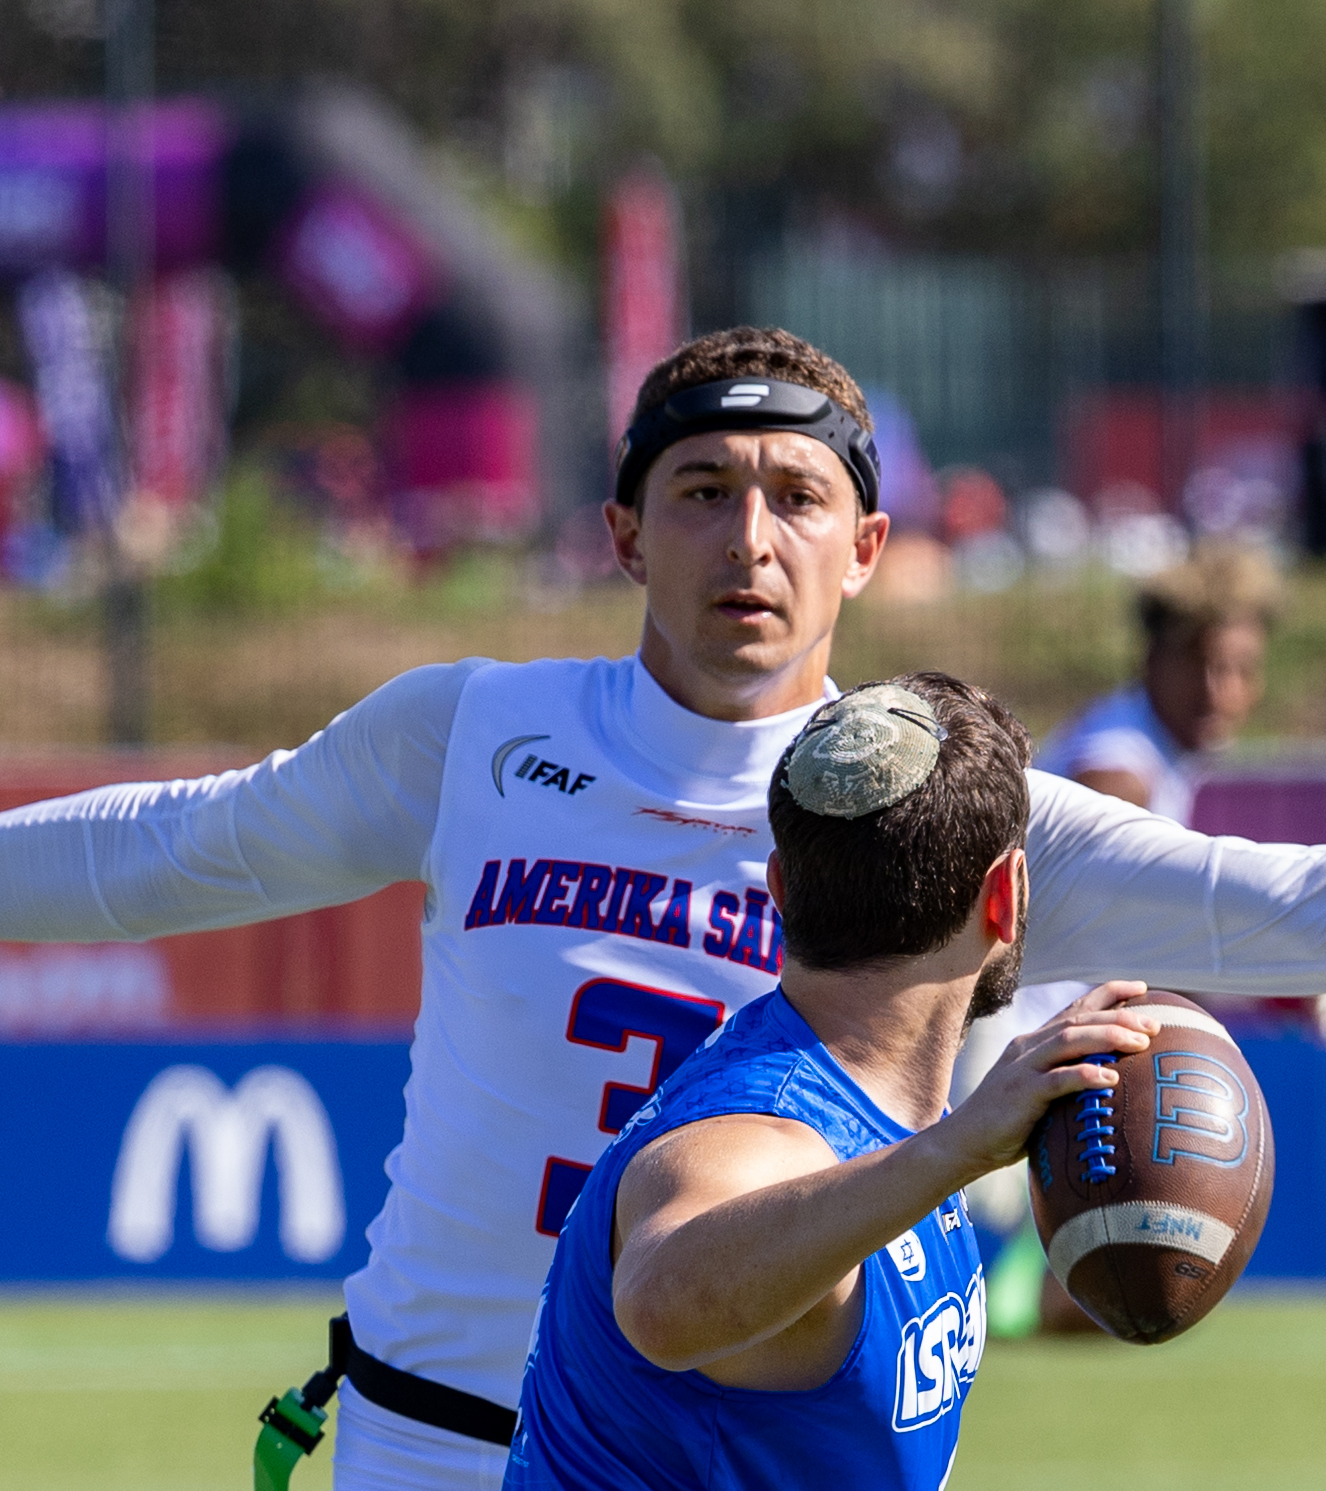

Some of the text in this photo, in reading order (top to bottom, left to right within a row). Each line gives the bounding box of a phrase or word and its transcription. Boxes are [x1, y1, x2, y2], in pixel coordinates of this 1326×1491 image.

[515, 753, 597, 796] IFAF
[464, 858, 693, 949] AMERIKA
[536, 976, 725, 1240] 3
